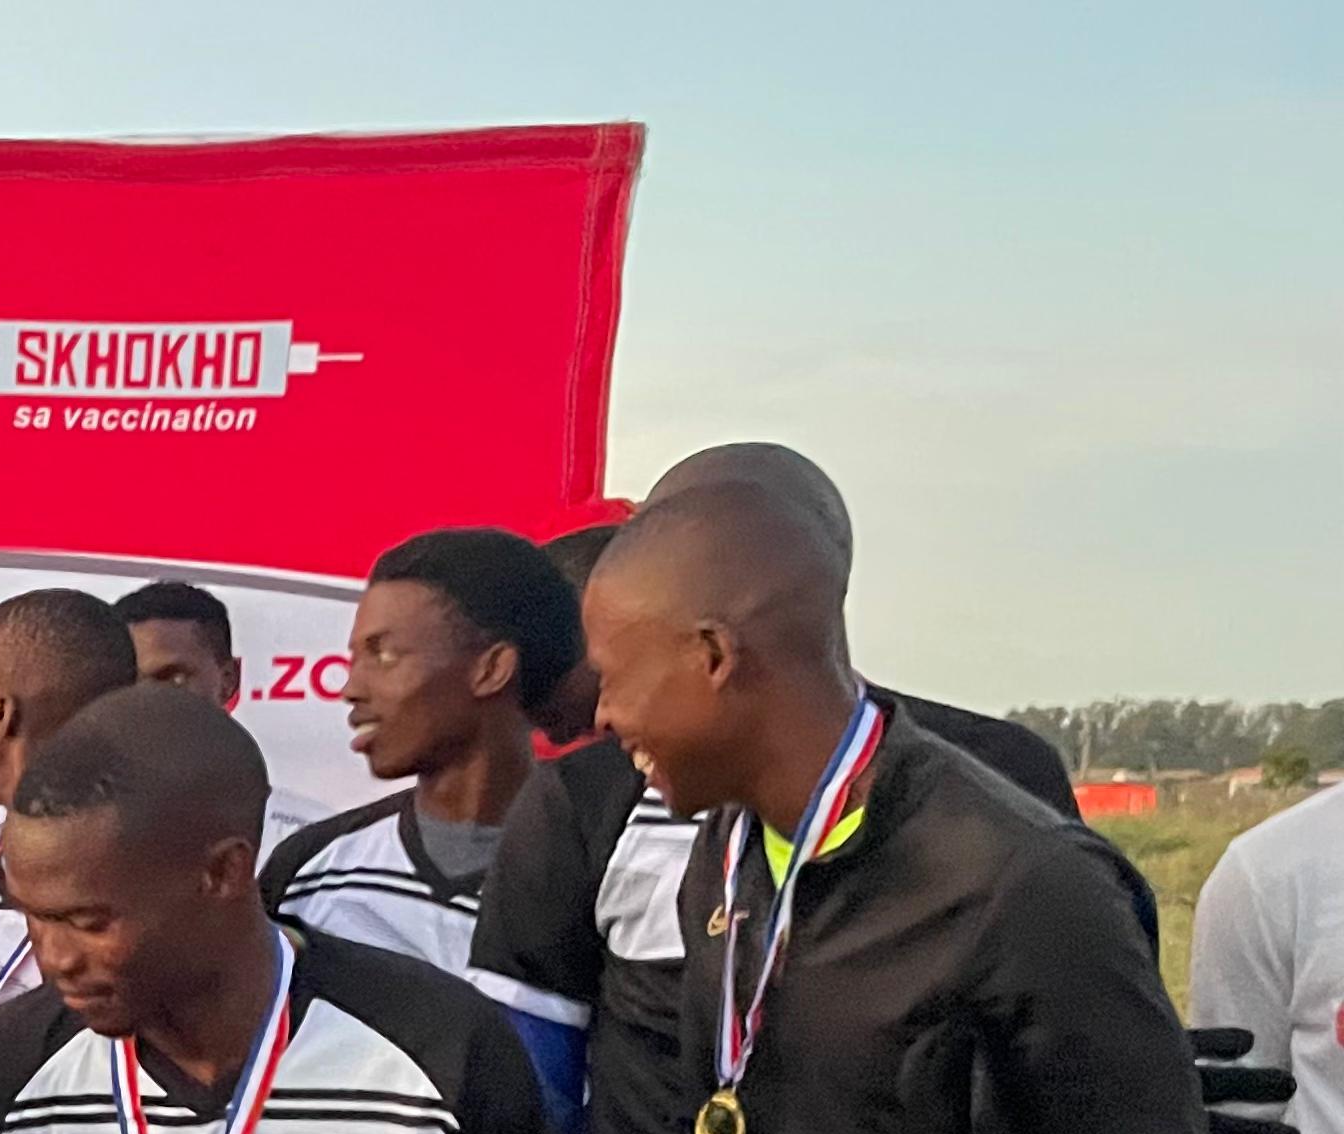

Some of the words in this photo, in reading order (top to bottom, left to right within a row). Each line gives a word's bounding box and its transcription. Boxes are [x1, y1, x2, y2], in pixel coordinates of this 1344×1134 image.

[16, 329, 263, 389] SKHOKHO
[13, 405, 52, 430] sa
[63, 400, 258, 432] vaccination
